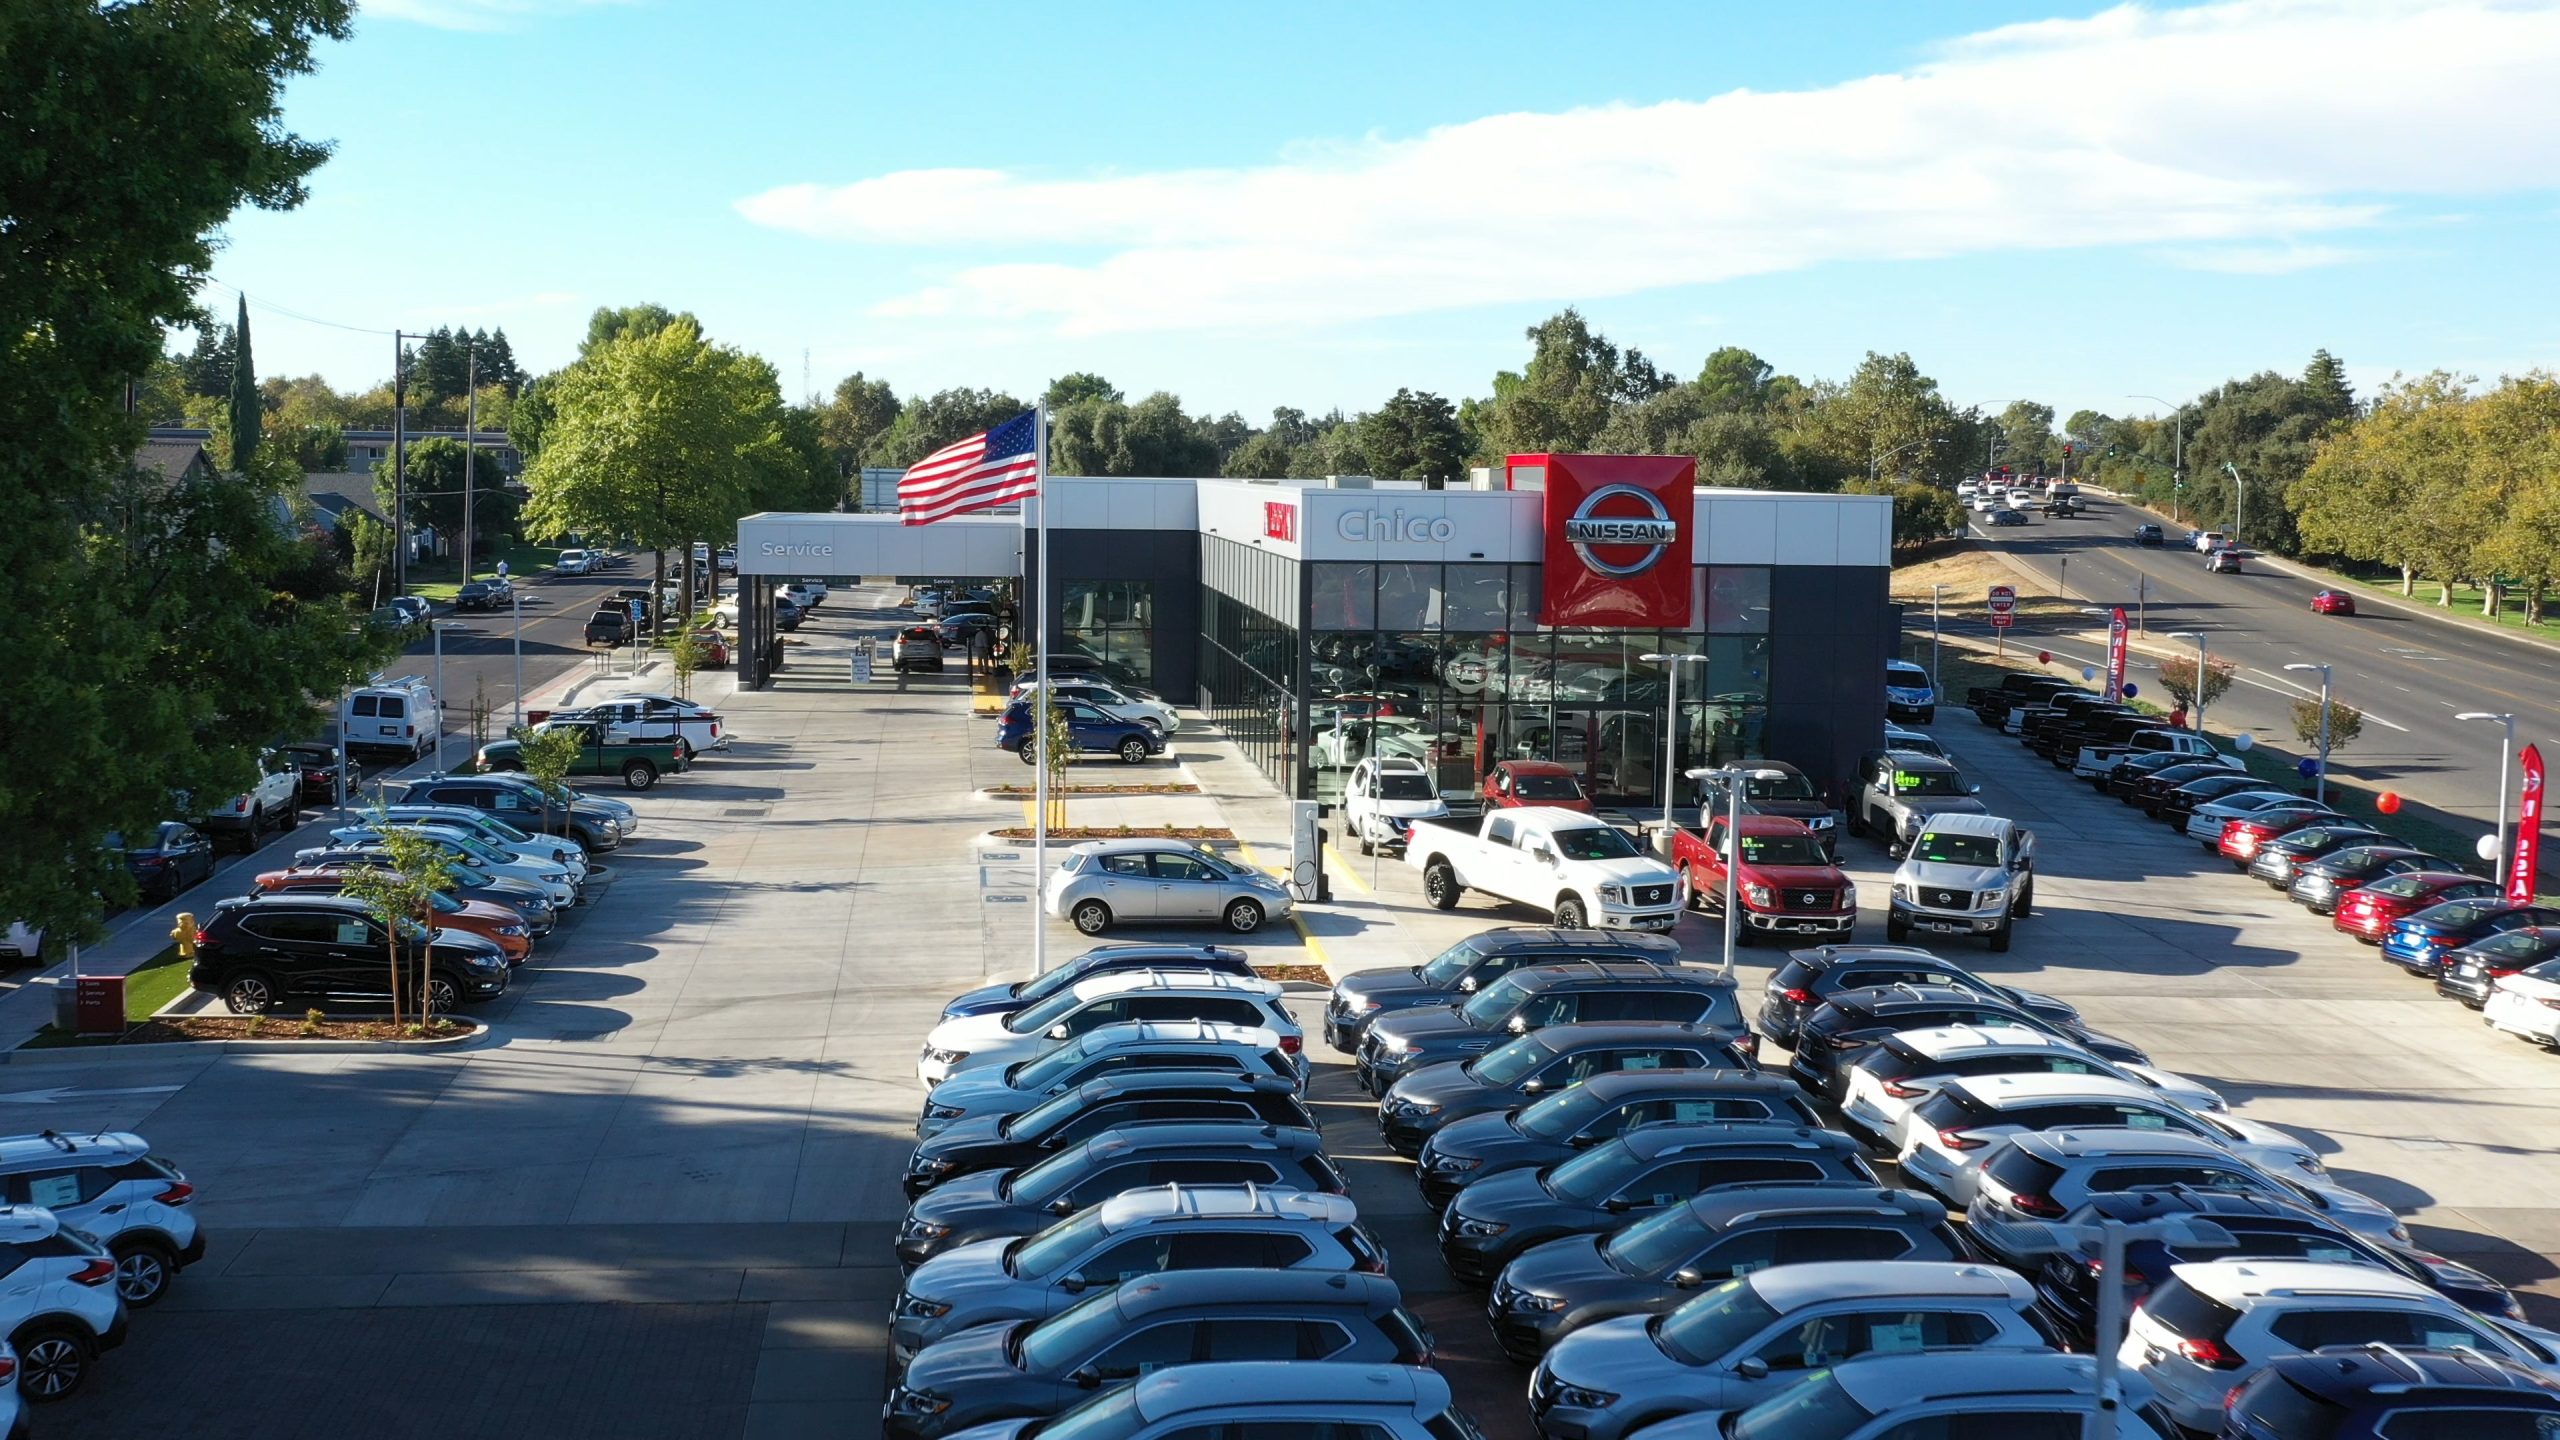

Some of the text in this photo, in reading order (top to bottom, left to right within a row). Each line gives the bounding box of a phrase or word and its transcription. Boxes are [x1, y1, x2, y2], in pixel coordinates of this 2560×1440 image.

[1337, 508, 1456, 543] Chico
[1577, 522, 1667, 540] NISSAN
[760, 541, 833, 557] Service
